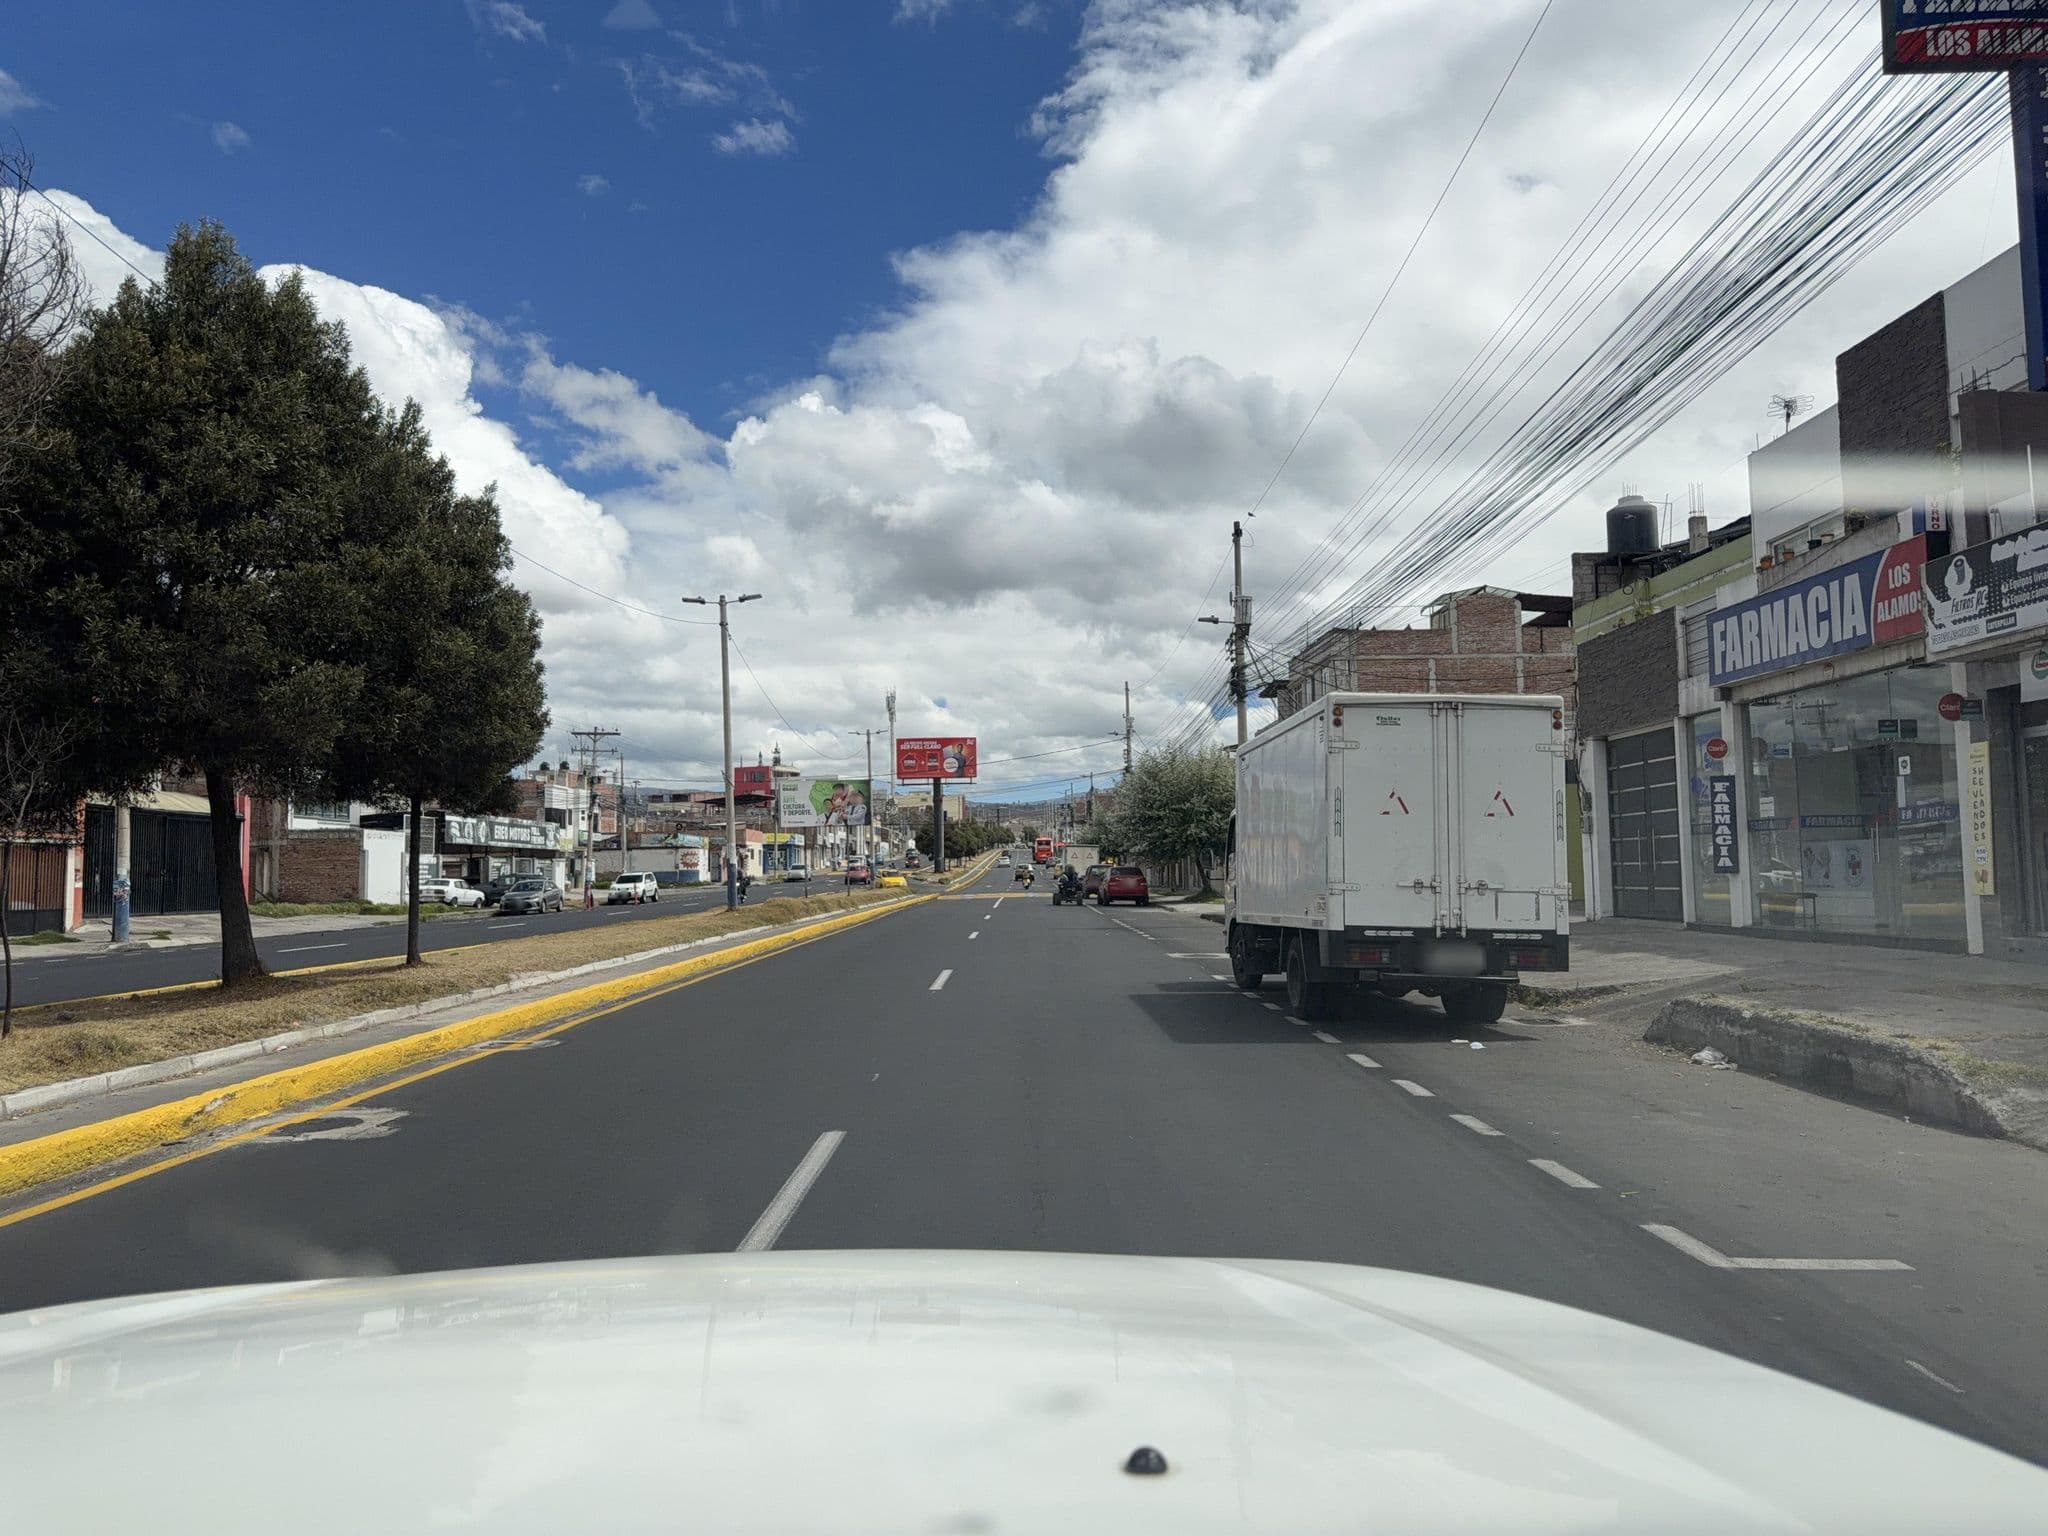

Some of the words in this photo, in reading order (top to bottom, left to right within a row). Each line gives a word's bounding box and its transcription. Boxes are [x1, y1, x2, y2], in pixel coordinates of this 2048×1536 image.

[1926, 28, 1971, 57] LOS
[1976, 27, 2048, 55] ALAM
[1888, 562, 1911, 589] LOS
[1712, 572, 1867, 676] FARMACIA
[1713, 782, 1734, 867] FARMACIA
